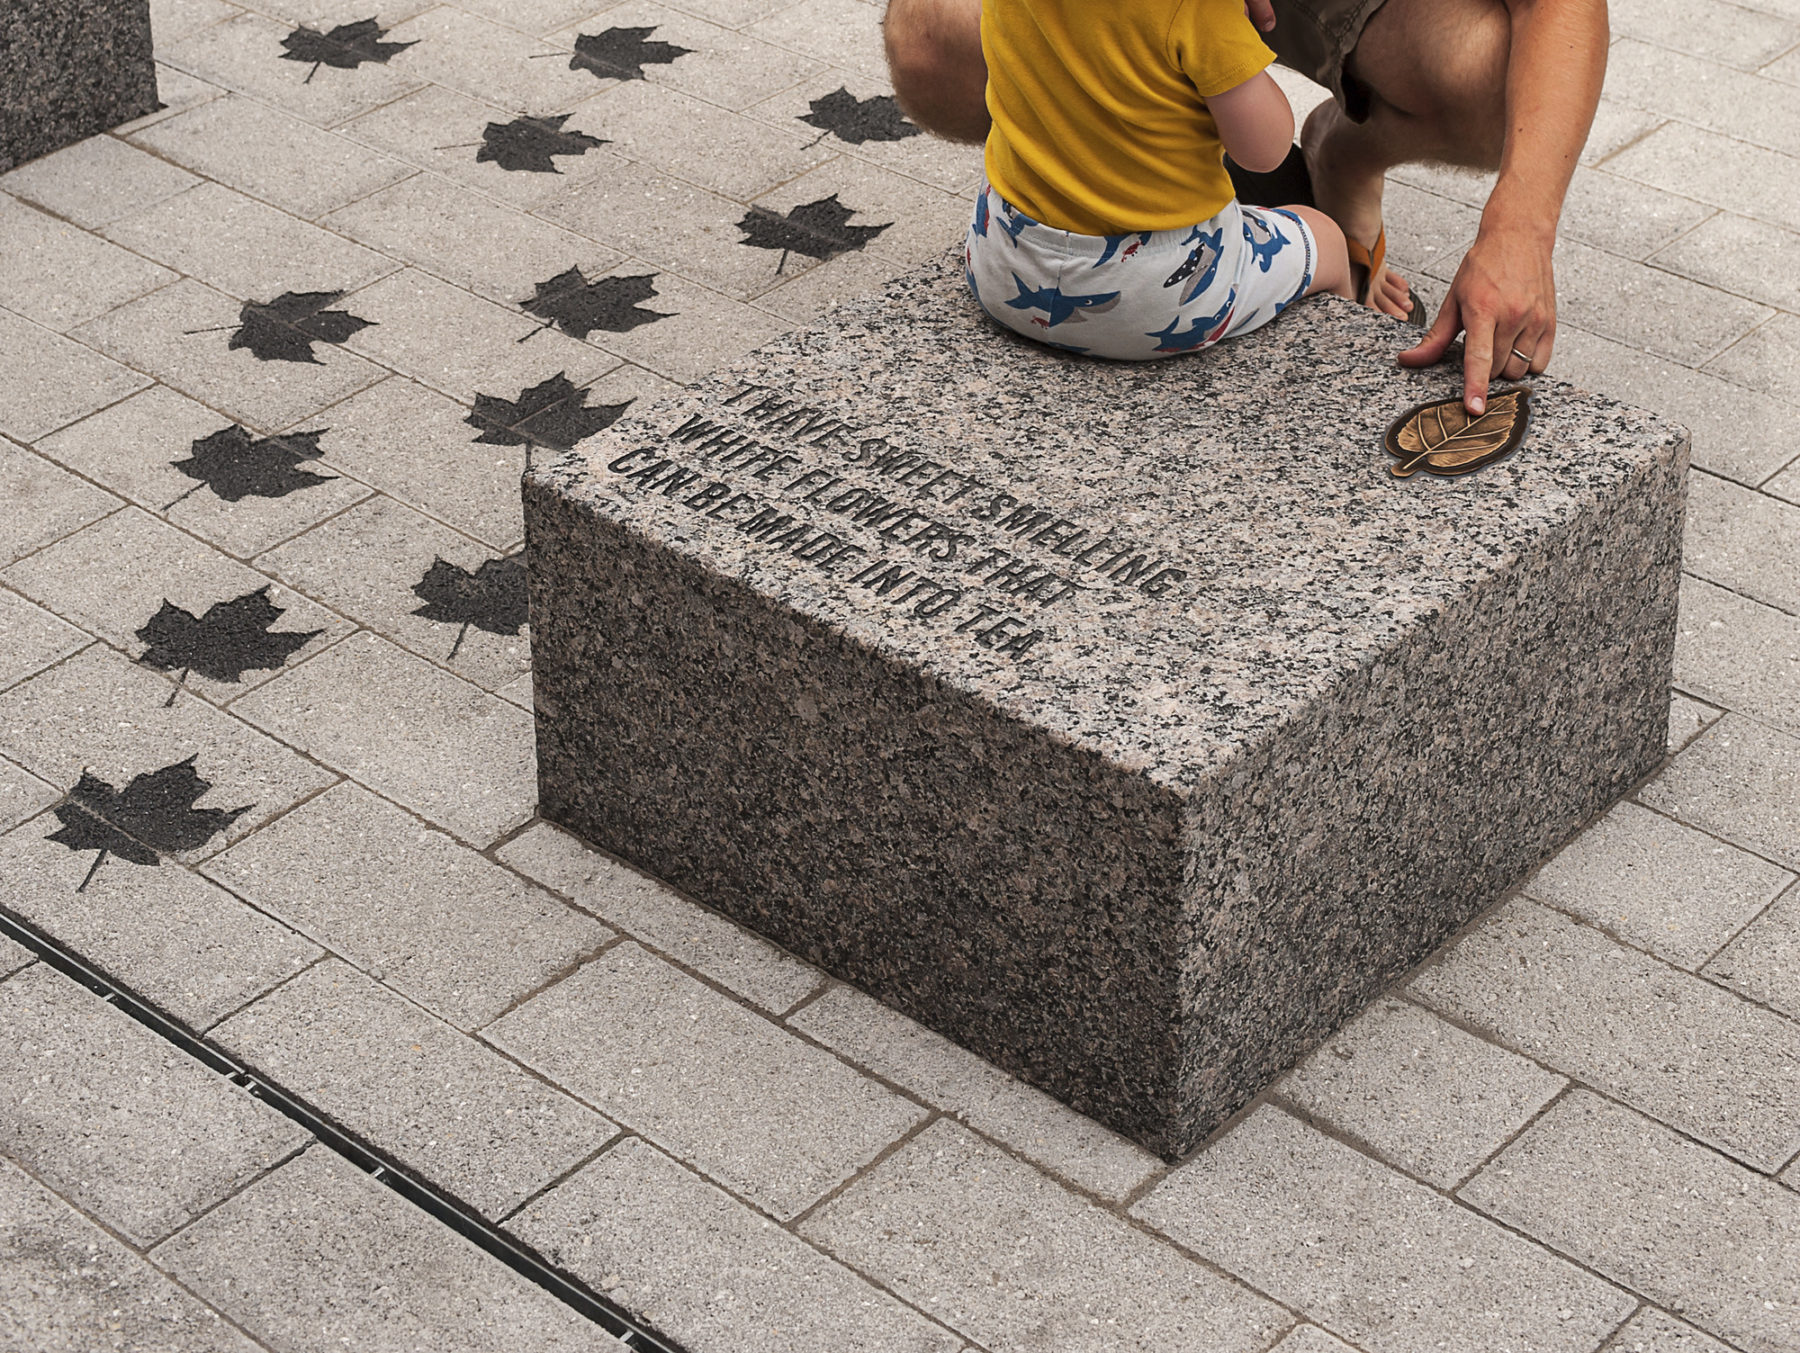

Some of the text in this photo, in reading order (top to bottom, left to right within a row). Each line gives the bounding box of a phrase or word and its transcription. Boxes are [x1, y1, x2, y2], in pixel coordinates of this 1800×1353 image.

[607, 448, 702, 496] CAN
[683, 482, 756, 521] BE
[736, 507, 868, 573] MADE
[849, 559, 962, 618] INTO
[669, 412, 1092, 609] WHITE FLOWERS THAT
[741, 394, 857, 451] HAVE
[842, 437, 986, 505] SWEET
[970, 494, 1187, 598] SMELLING
